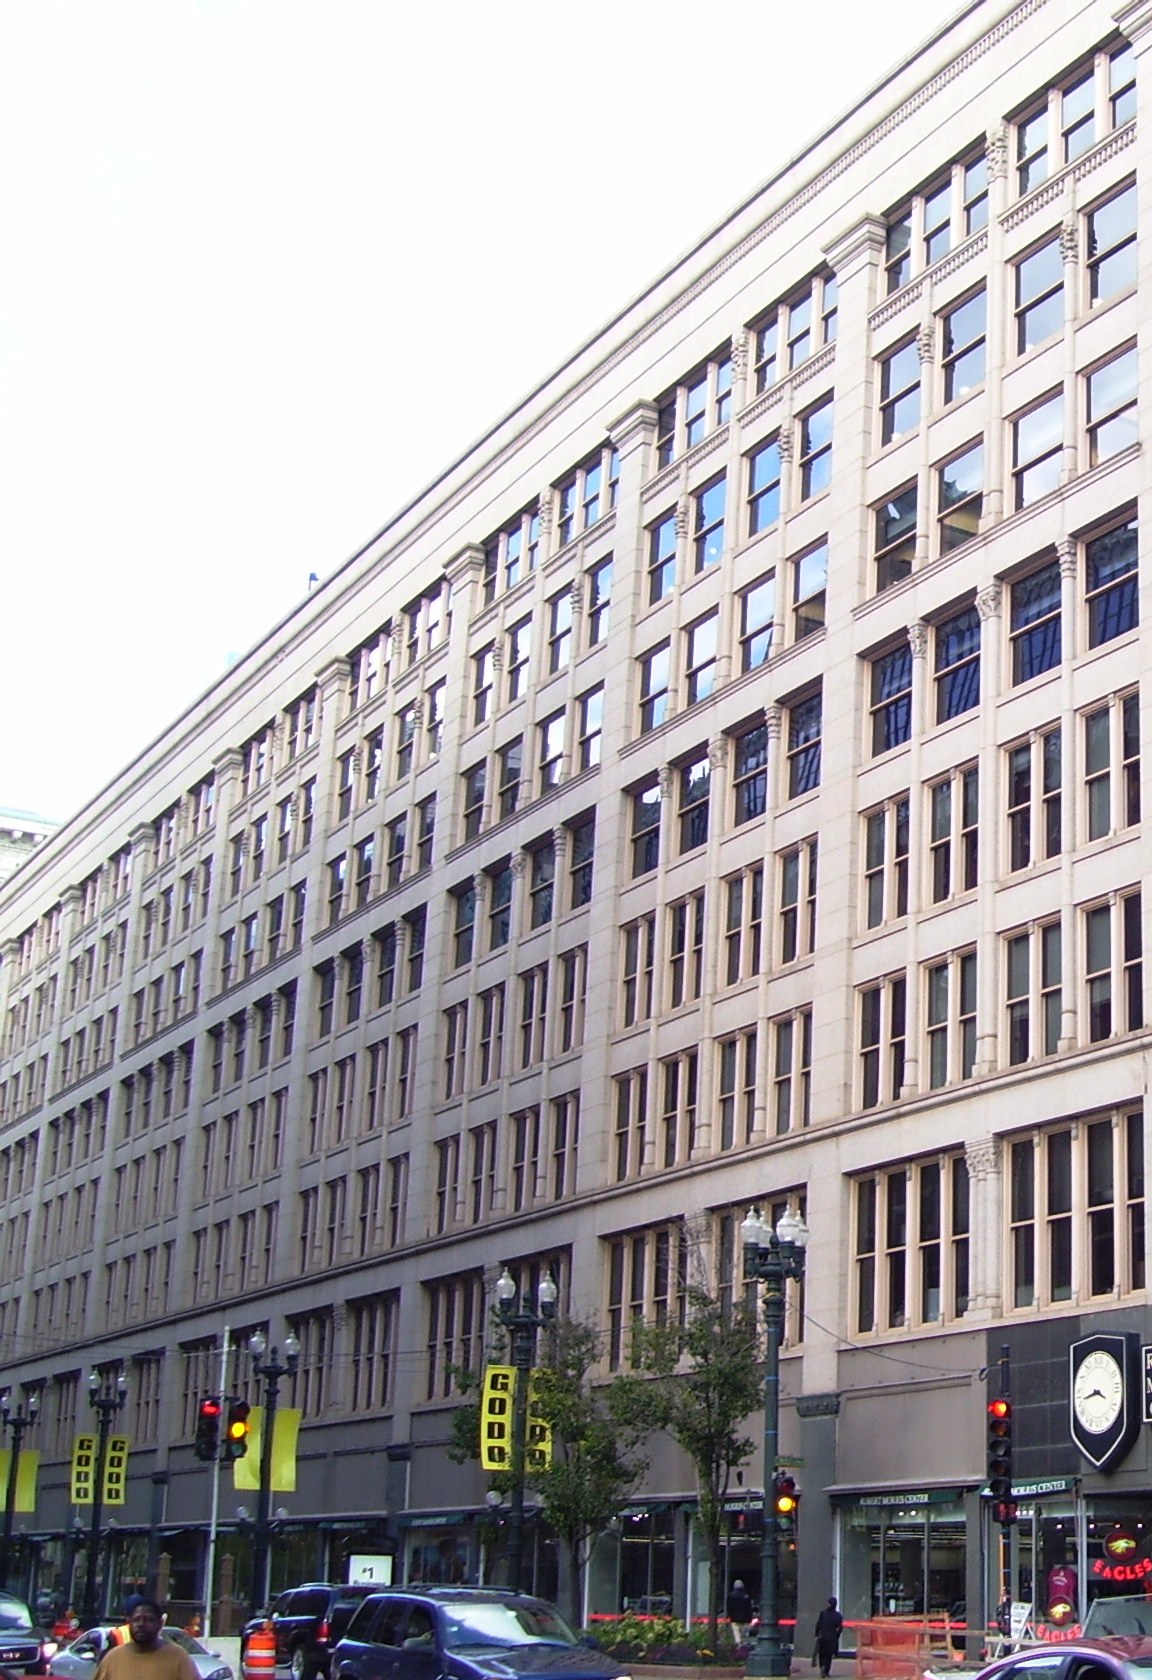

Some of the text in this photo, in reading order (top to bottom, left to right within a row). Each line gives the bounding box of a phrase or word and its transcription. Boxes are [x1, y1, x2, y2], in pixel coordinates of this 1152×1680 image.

[487, 1373, 510, 1463] GOOD
[75, 1438, 94, 1499] GOOD
[107, 1440, 126, 1500] GOOD
[1038, 1480, 1066, 1493] CENTER
[1037, 1623, 1082, 1643] EAGLES
